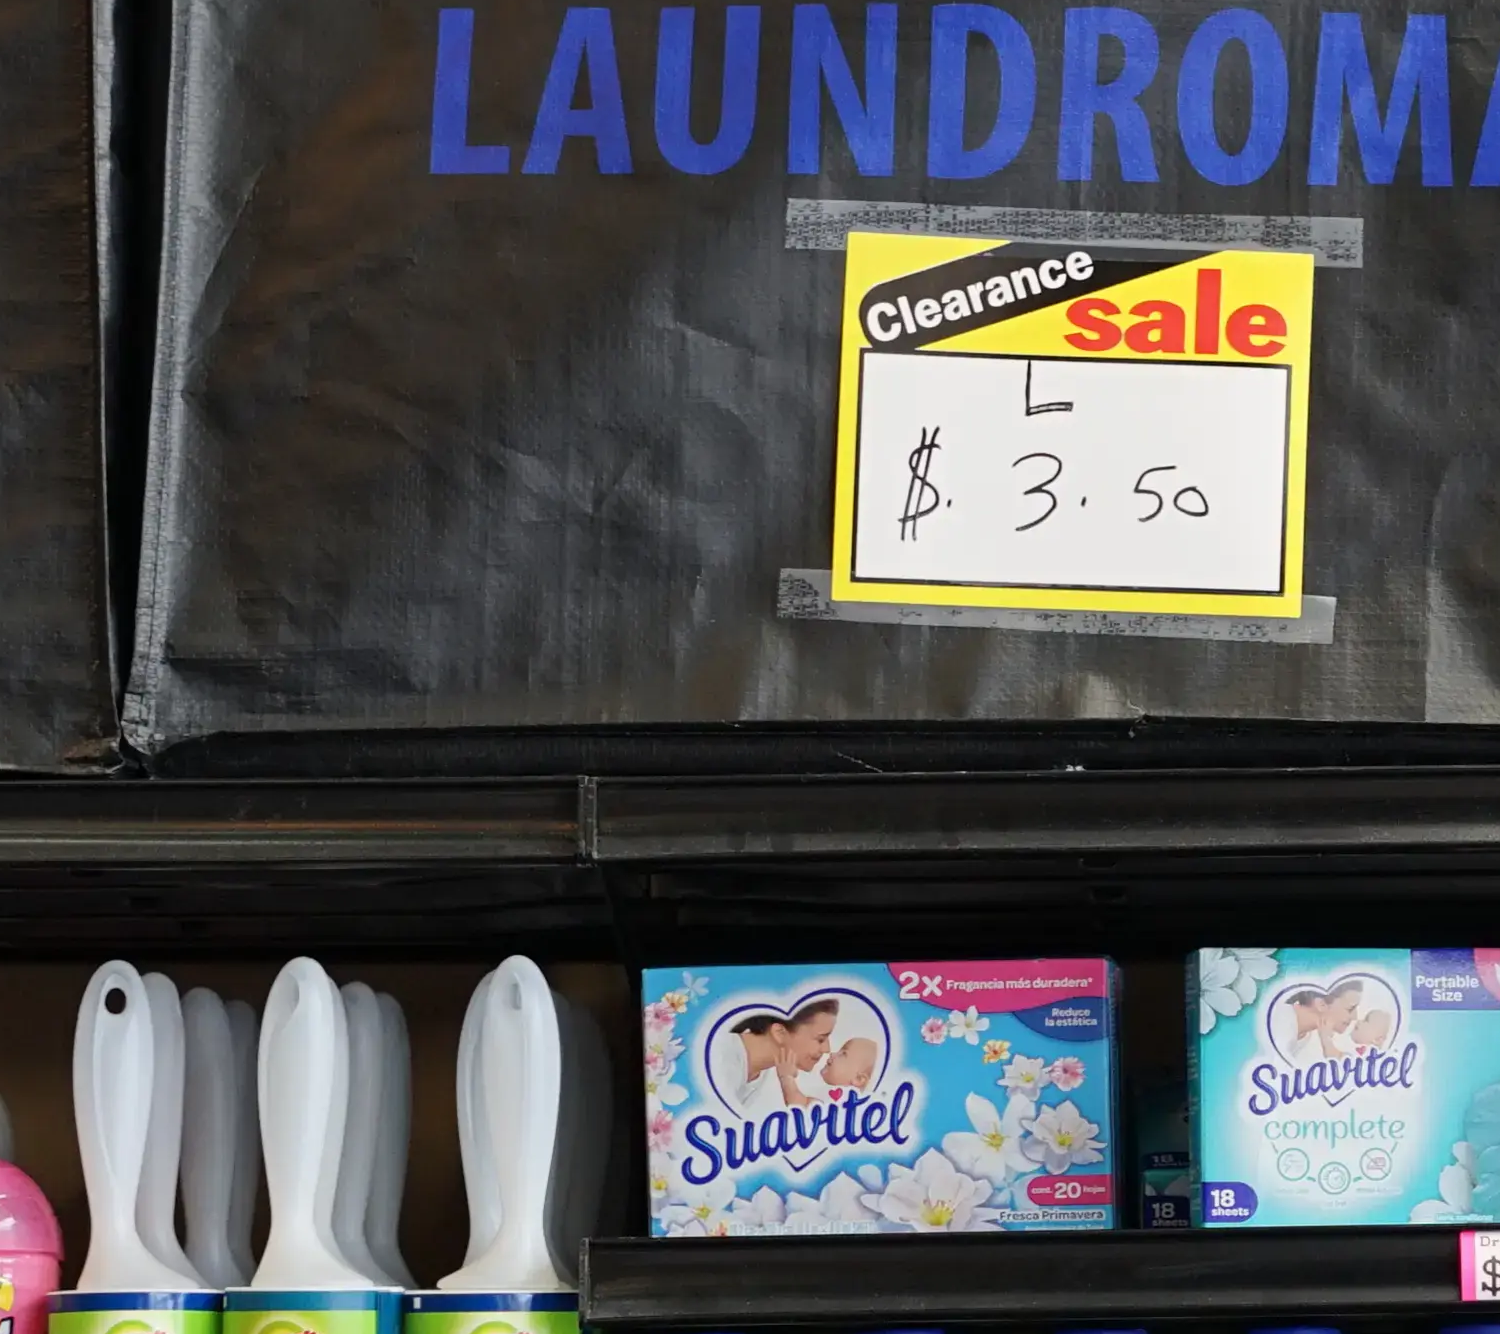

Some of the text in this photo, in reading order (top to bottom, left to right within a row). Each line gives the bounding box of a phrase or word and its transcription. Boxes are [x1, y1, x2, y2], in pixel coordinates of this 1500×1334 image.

[866, 250, 1094, 343] Clearance
[1063, 268, 1288, 359] sale
[1025, 358, 1074, 417] L
[899, 971, 943, 999] 2X
[946, 979, 1004, 992] Fragancia
[1006, 977, 1031, 989] más
[1248, 1042, 1418, 1117] Suavitel
[681, 1081, 917, 1187] Suavitel
[1264, 1114, 1406, 1149] complete
[1000, 1210, 1104, 1223] Fresca Primavera
[1054, 1182, 1082, 1200] 20
